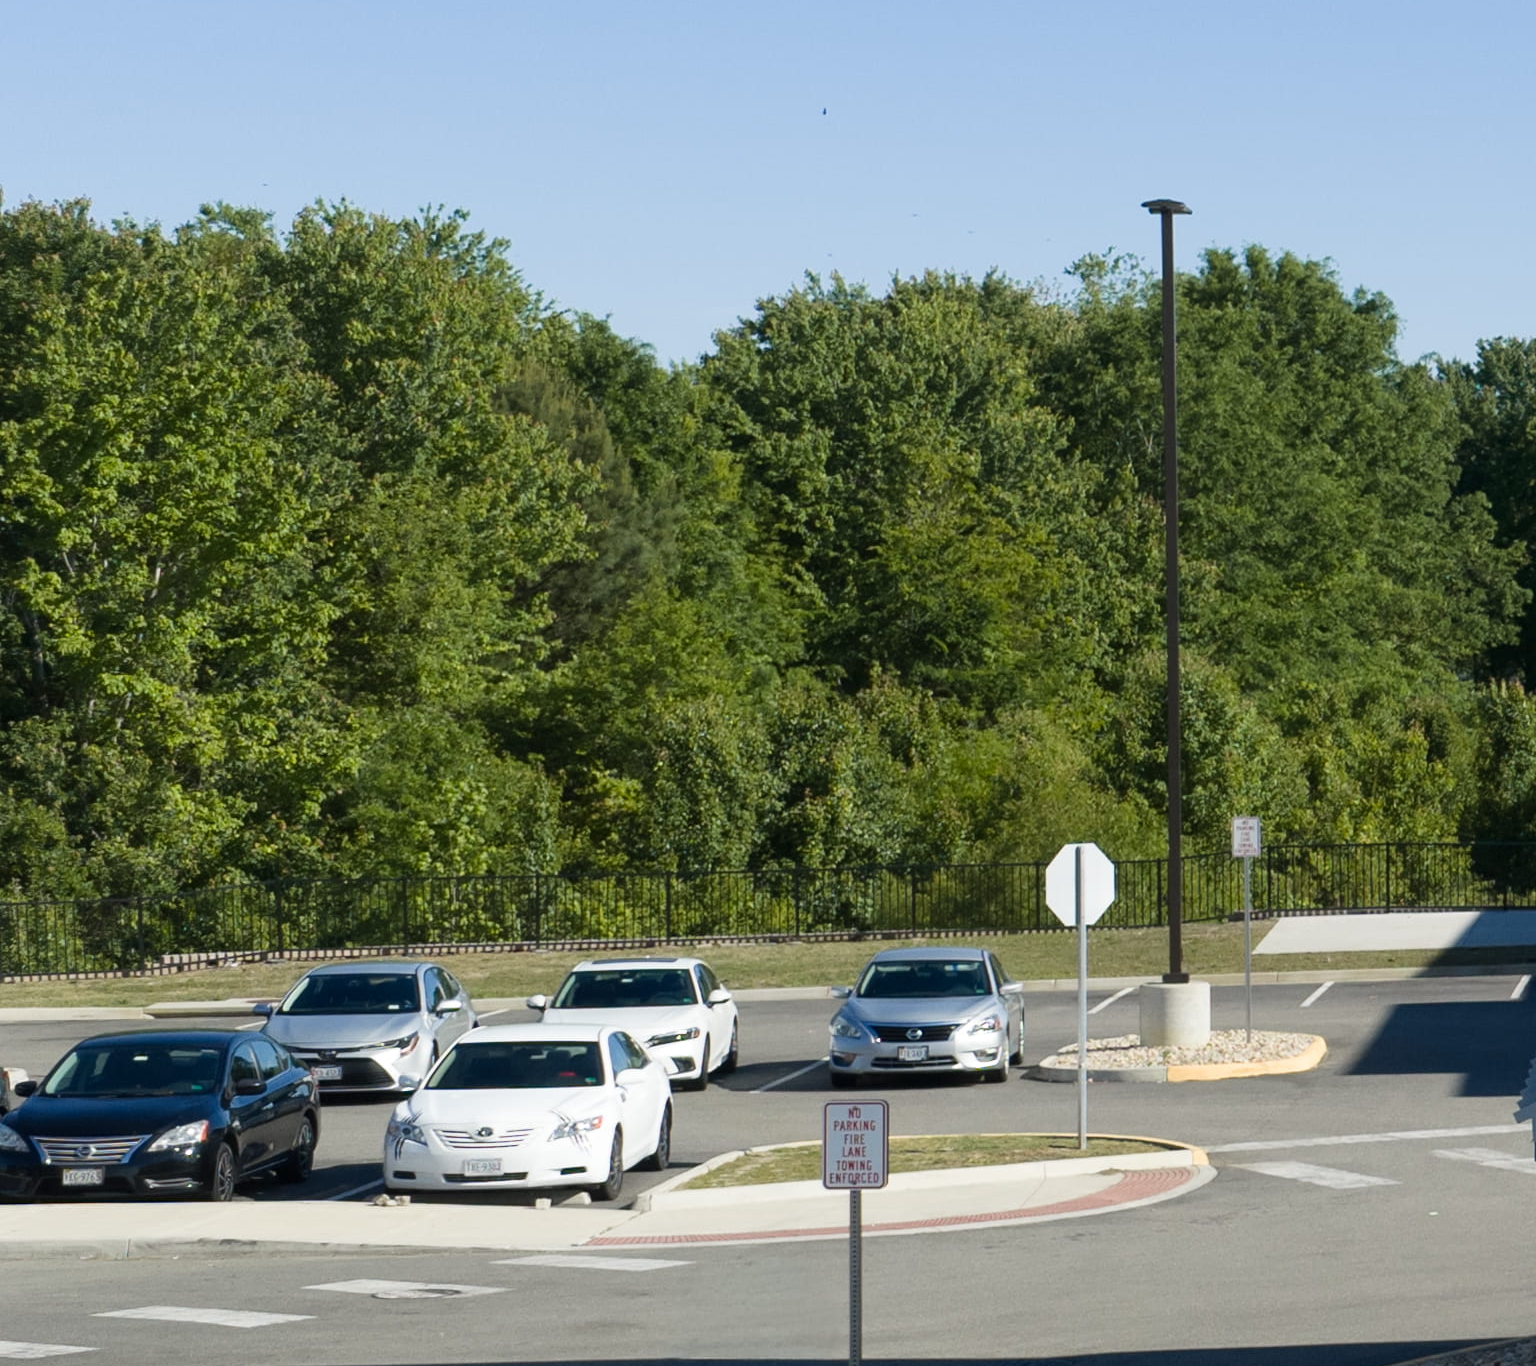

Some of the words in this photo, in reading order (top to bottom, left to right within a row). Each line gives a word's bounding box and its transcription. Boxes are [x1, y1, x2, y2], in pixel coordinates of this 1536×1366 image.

[848, 1107, 861, 1119] NO
[833, 1120, 877, 1131] PARKING
[844, 1133, 866, 1145] FIRE
[842, 1146, 867, 1157] LANE
[836, 1159, 872, 1171] TOWING
[829, 1172, 880, 1185] ENFORCED
